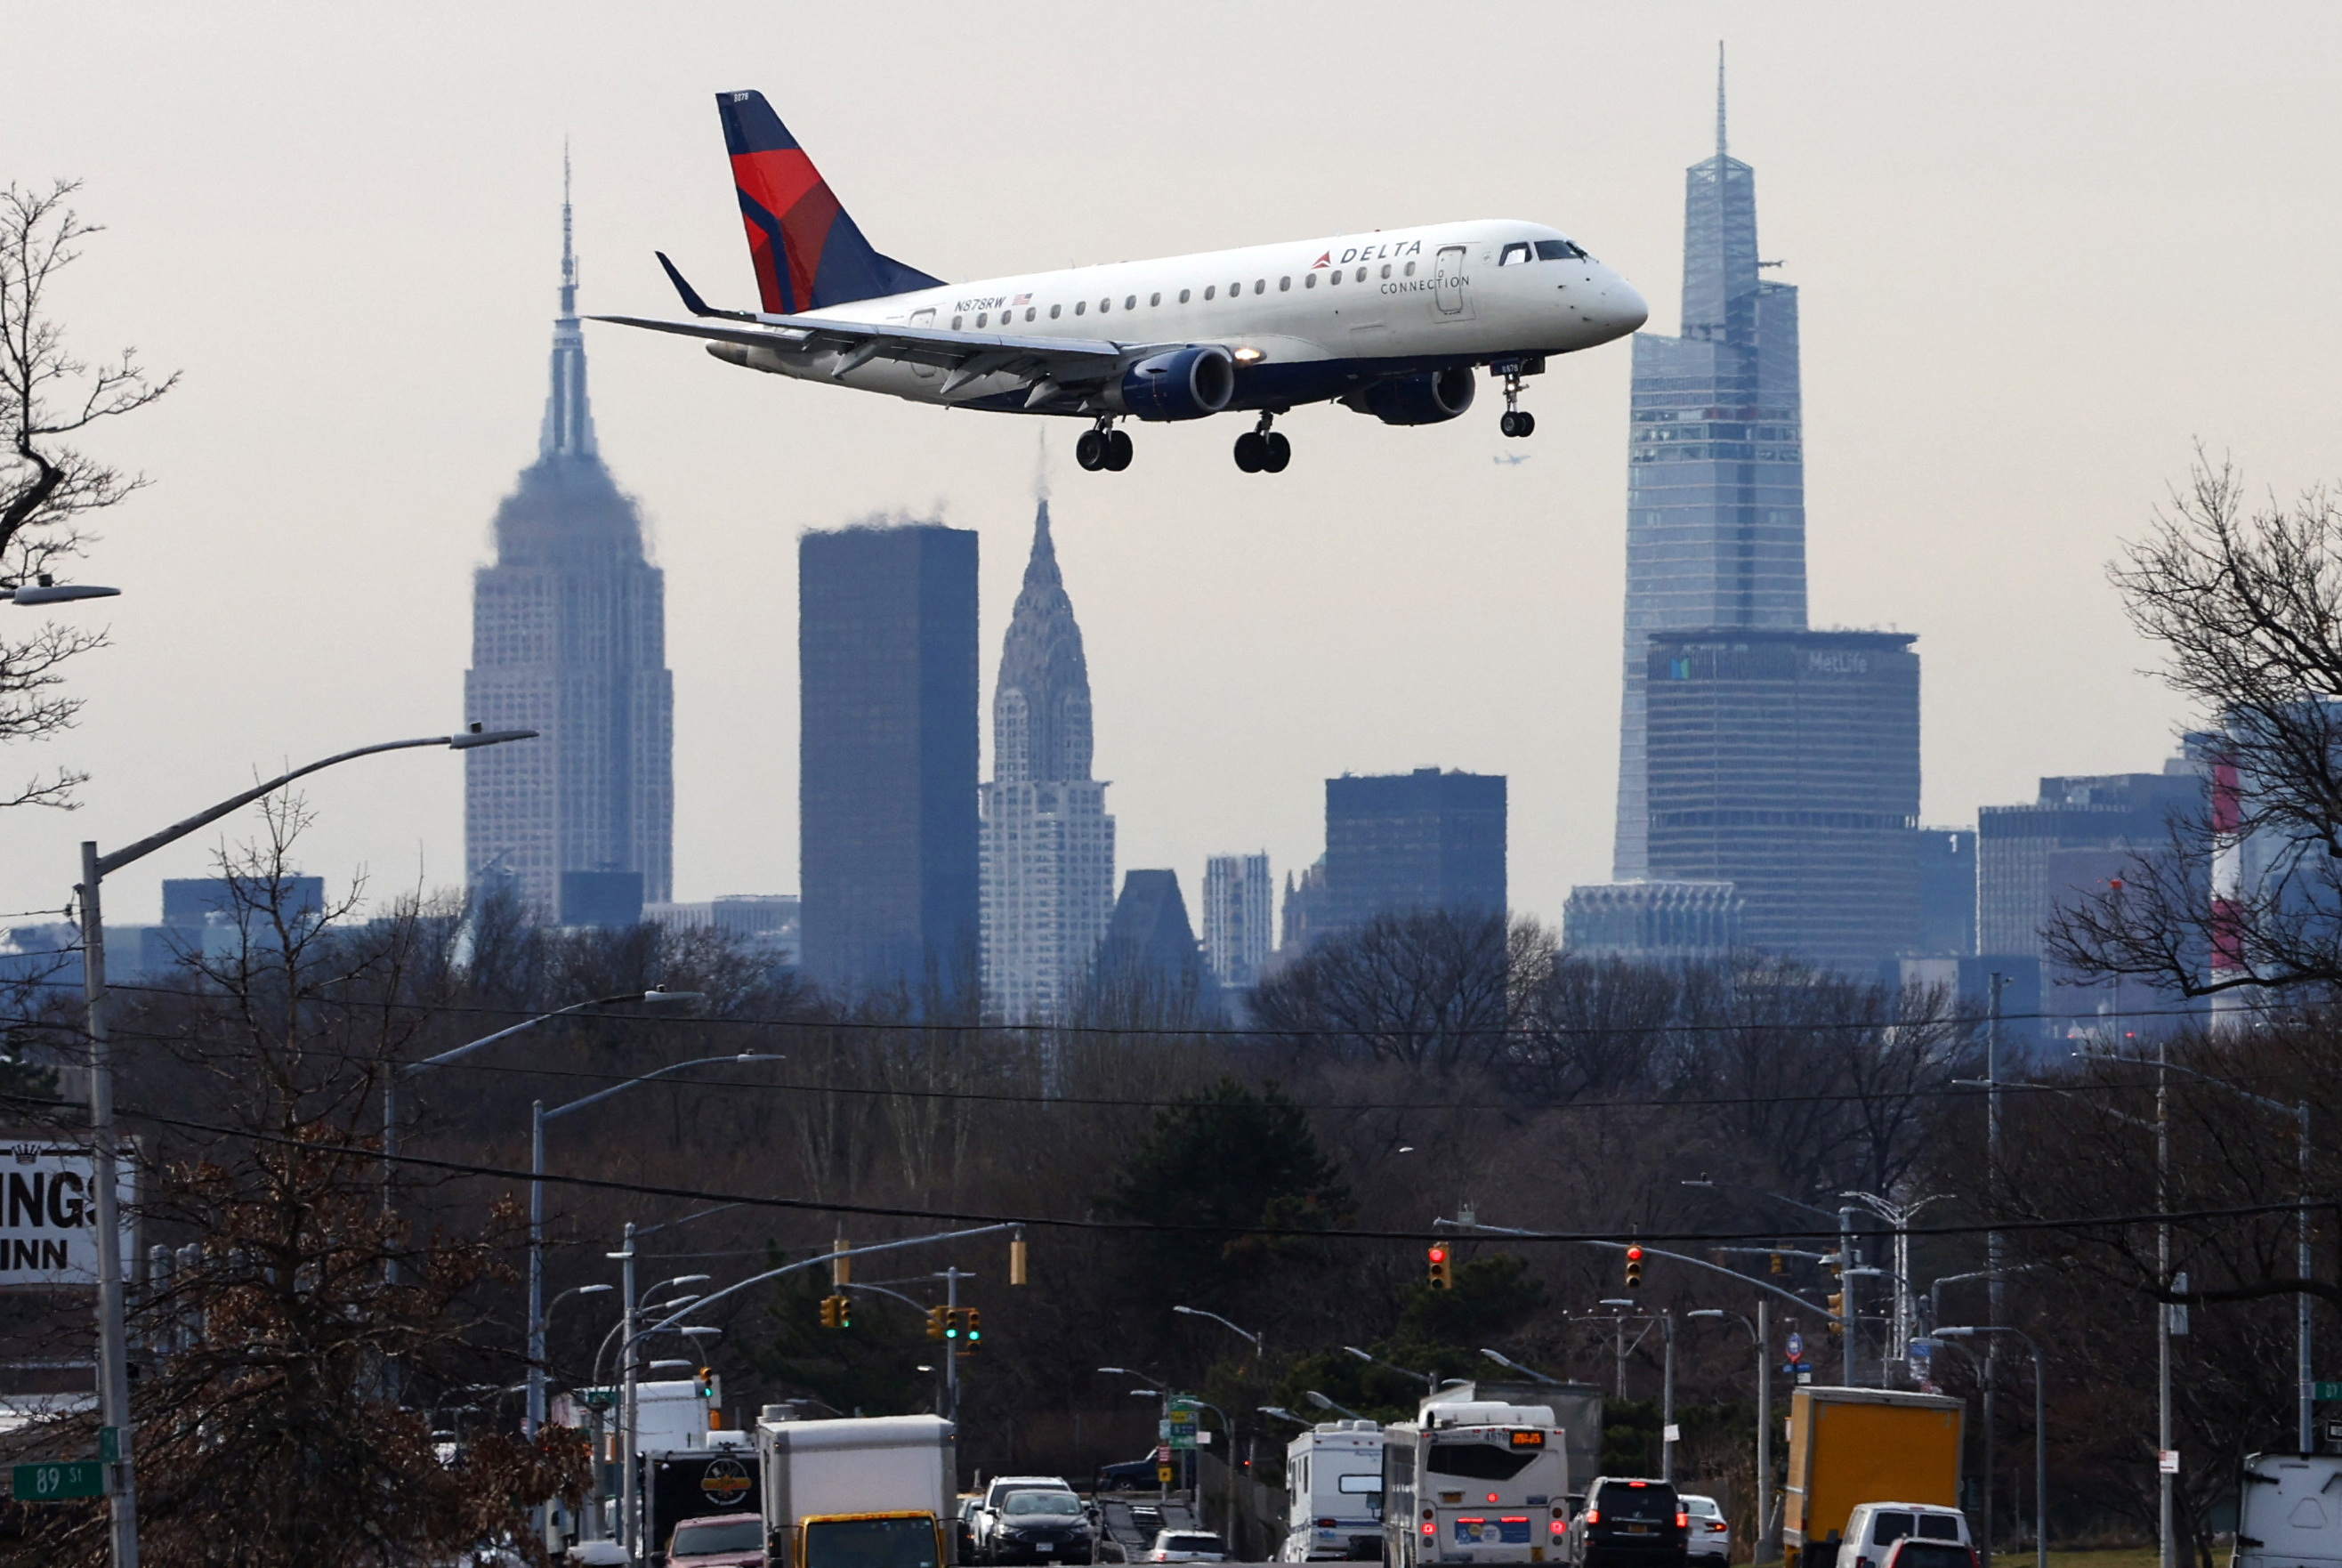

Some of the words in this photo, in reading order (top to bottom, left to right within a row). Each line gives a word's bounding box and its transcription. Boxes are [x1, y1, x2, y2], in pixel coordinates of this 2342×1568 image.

[1340, 239, 1422, 264] DELTA
[1380, 276, 1470, 295] CONNECTION
[954, 295, 1007, 312] N878RW
[1808, 651, 1868, 673] MetLife
[0, 1239, 68, 1270] INN
[36, 1467, 61, 1494] 89
[69, 1467, 83, 1483] St
